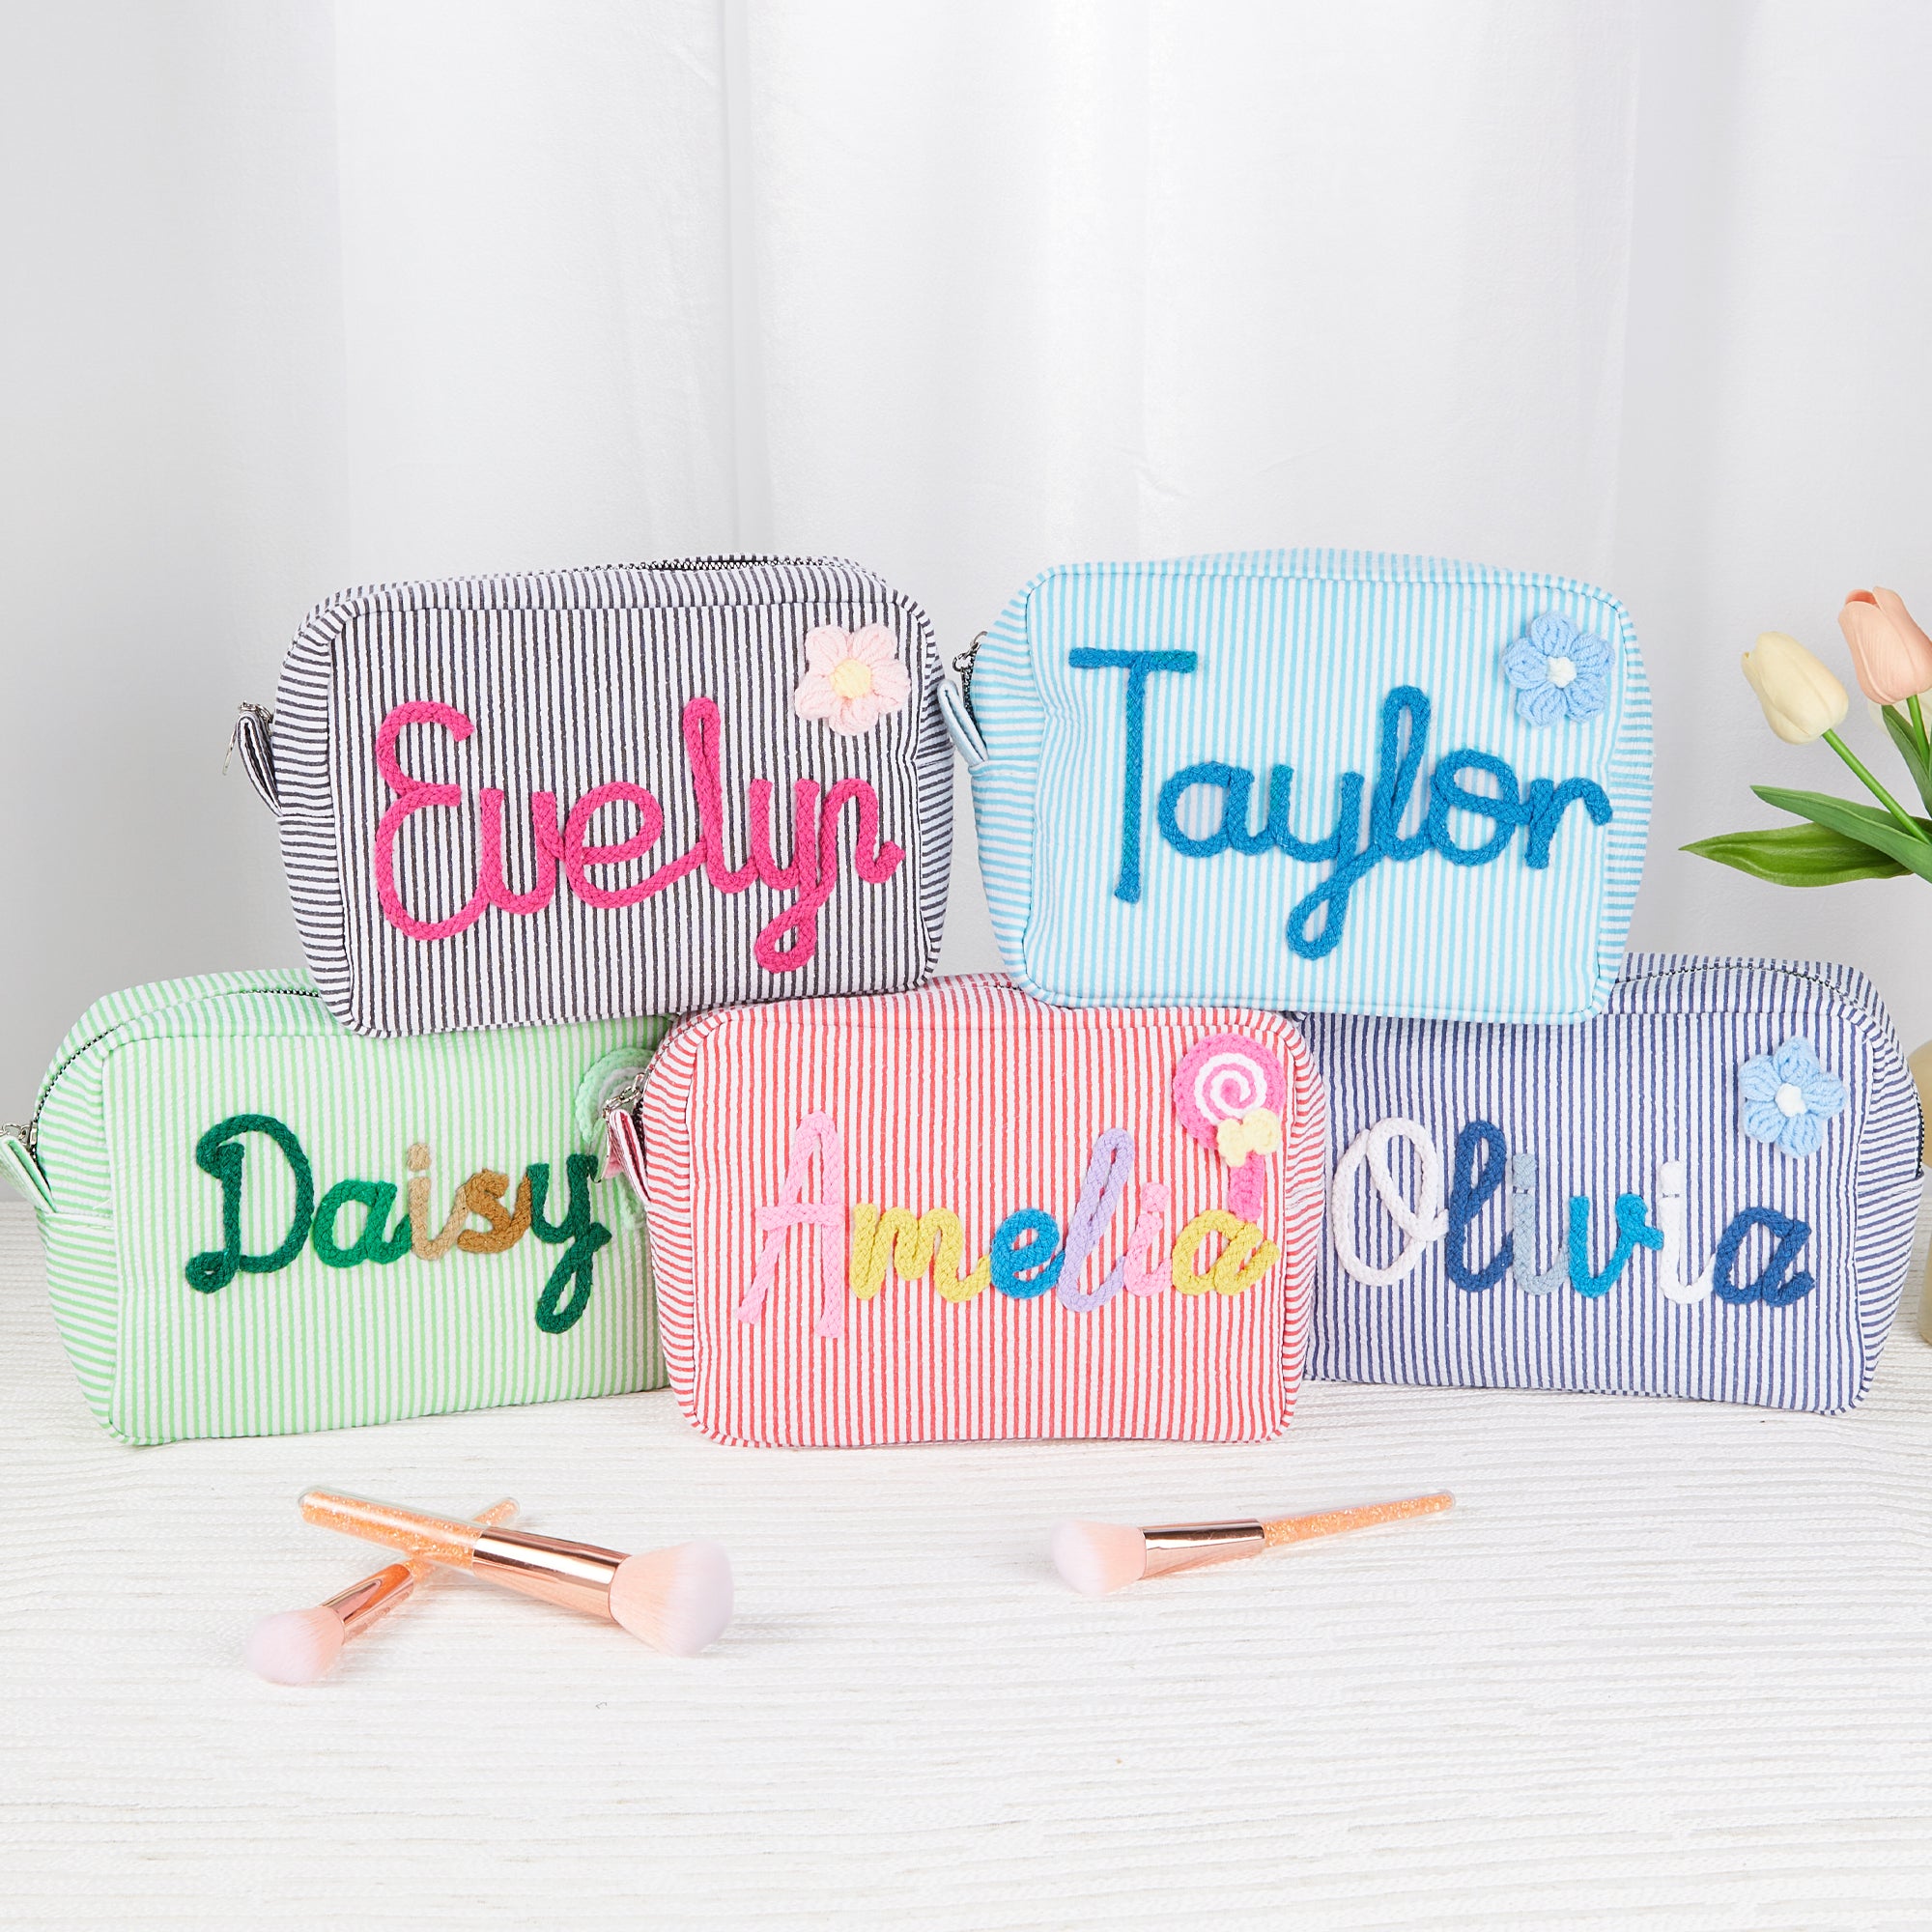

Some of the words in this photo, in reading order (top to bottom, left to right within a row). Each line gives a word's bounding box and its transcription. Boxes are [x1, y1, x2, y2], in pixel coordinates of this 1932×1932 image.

[376, 697, 903, 972] Evelyn
[1069, 648, 1611, 959] Taylor
[185, 1114, 611, 1334] Daisy
[733, 1112, 1281, 1338] Amelia
[1332, 1118, 1816, 1307] Olivia
